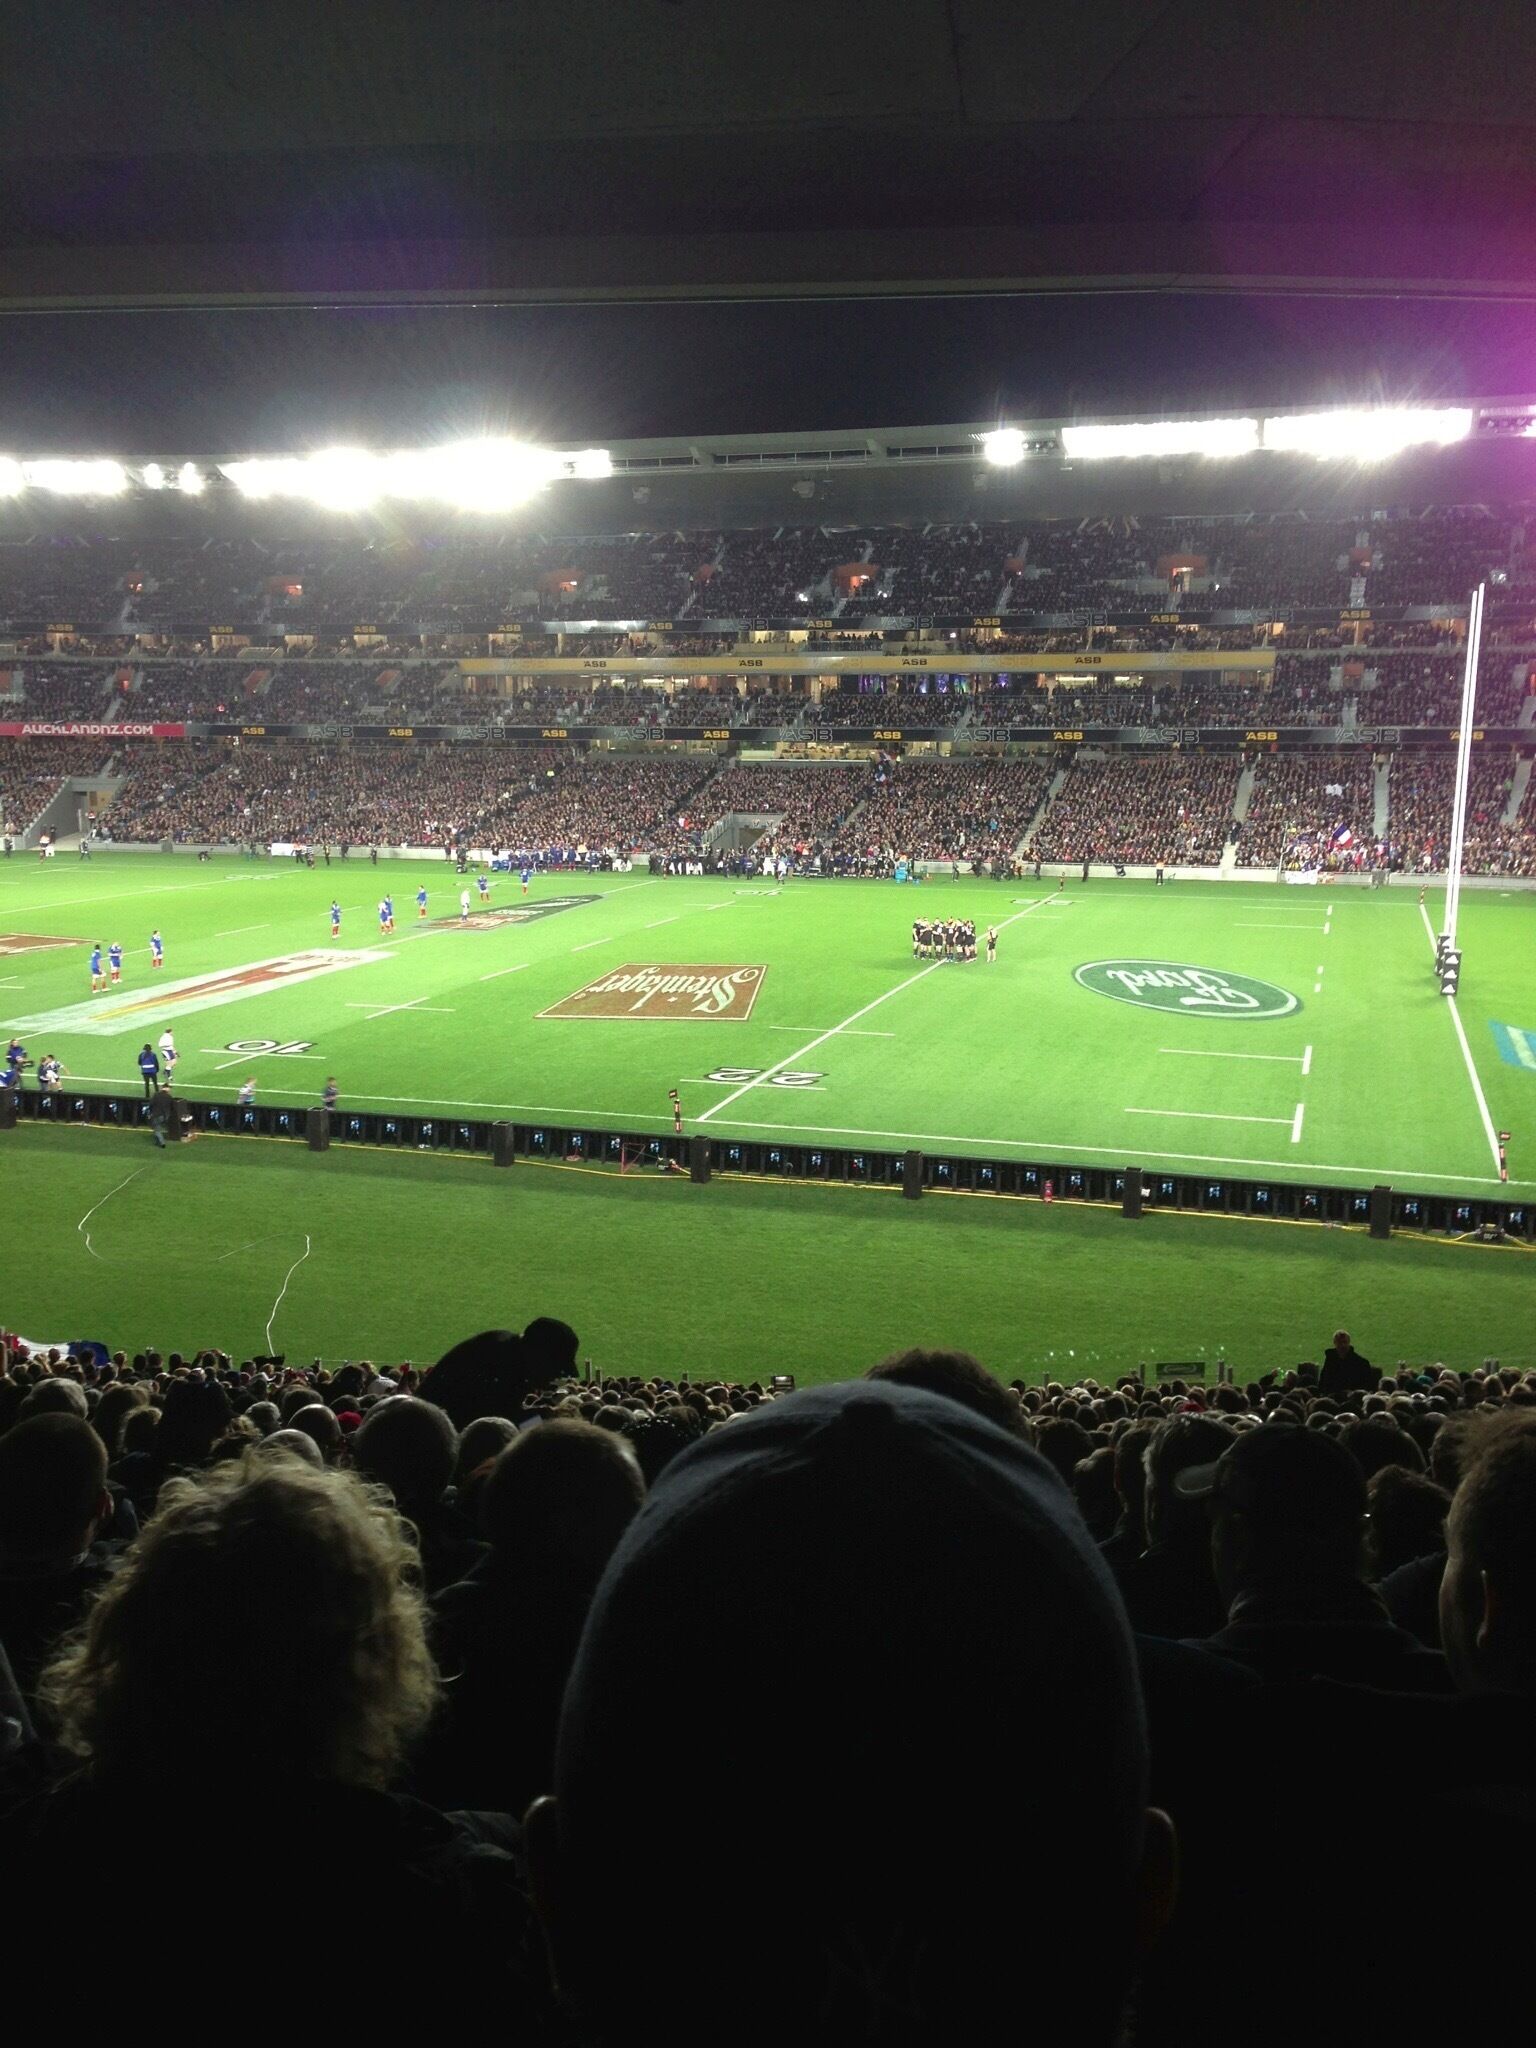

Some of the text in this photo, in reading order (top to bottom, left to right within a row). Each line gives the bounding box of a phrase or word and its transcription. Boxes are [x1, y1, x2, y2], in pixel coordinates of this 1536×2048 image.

[1151, 614, 1180, 623] ASB
[1340, 610, 1371, 619] ASB
[649, 622, 673, 630] ASB
[804, 620, 833, 628] ASB
[973, 617, 1001, 626] ASB
[47, 624, 74, 632] ASB
[353, 625, 377, 633] ASB
[497, 624, 521, 632] ASB
[584, 660, 607, 668] ASB
[739, 659, 763, 667] ASB
[902, 658, 928, 666] ASB
[1074, 656, 1102, 664] ASB
[242, 727, 265, 735] ASB
[388, 728, 413, 737] ASB
[542, 729, 568, 738] ASB
[703, 730, 730, 738] ASB
[873, 730, 902, 740] ASB
[1053, 731, 1083, 740] ASB
[1245, 731, 1278, 740] ASB
[1449, 731, 1485, 741] AB
[585, 966, 759, 1013] Steinlager
[1106, 969, 1260, 1008] Ford
[704, 1066, 830, 1086] 22
